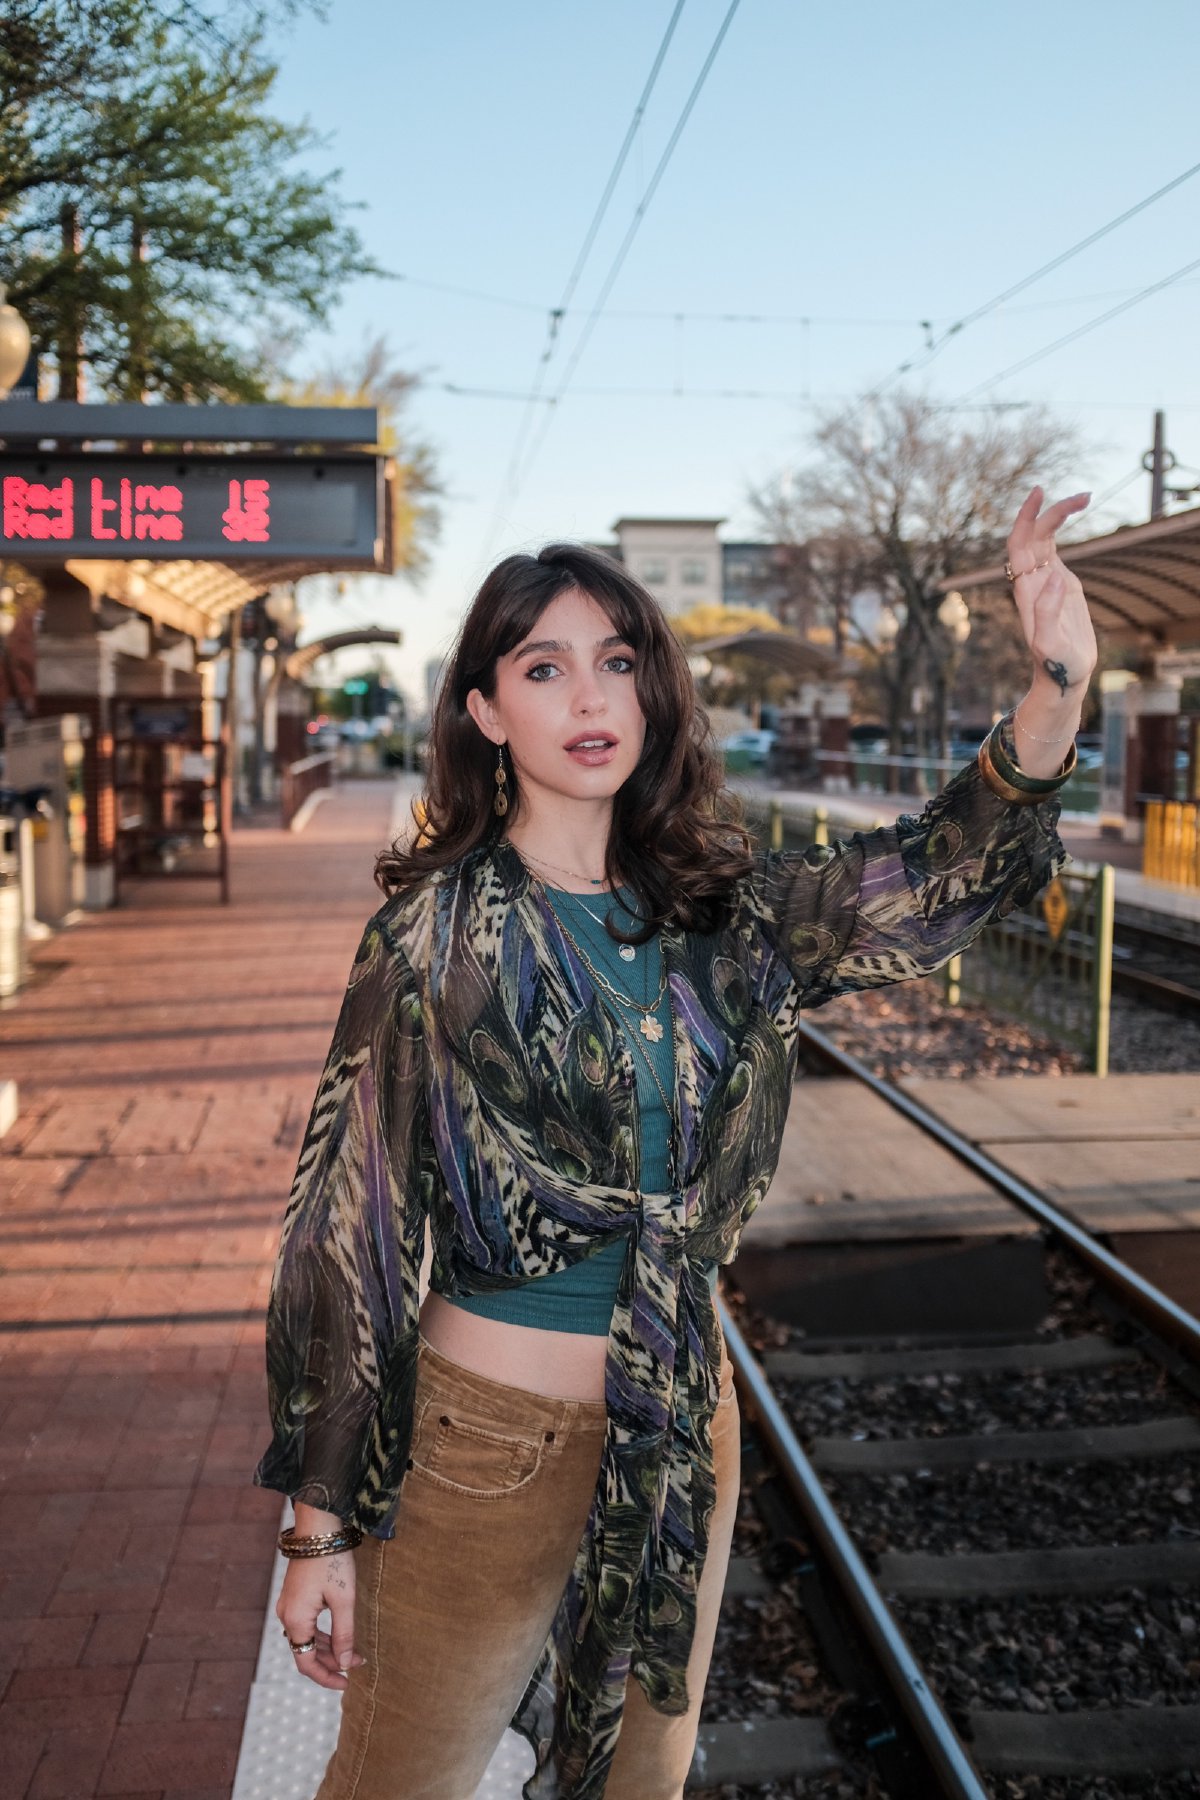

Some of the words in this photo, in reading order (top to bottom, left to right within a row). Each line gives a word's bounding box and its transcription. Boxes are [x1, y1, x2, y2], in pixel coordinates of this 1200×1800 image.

[3, 476, 74, 510] Red
[91, 477, 183, 512] Line
[229, 479, 270, 511] 15
[3, 507, 74, 539] Red
[91, 507, 183, 541] Line
